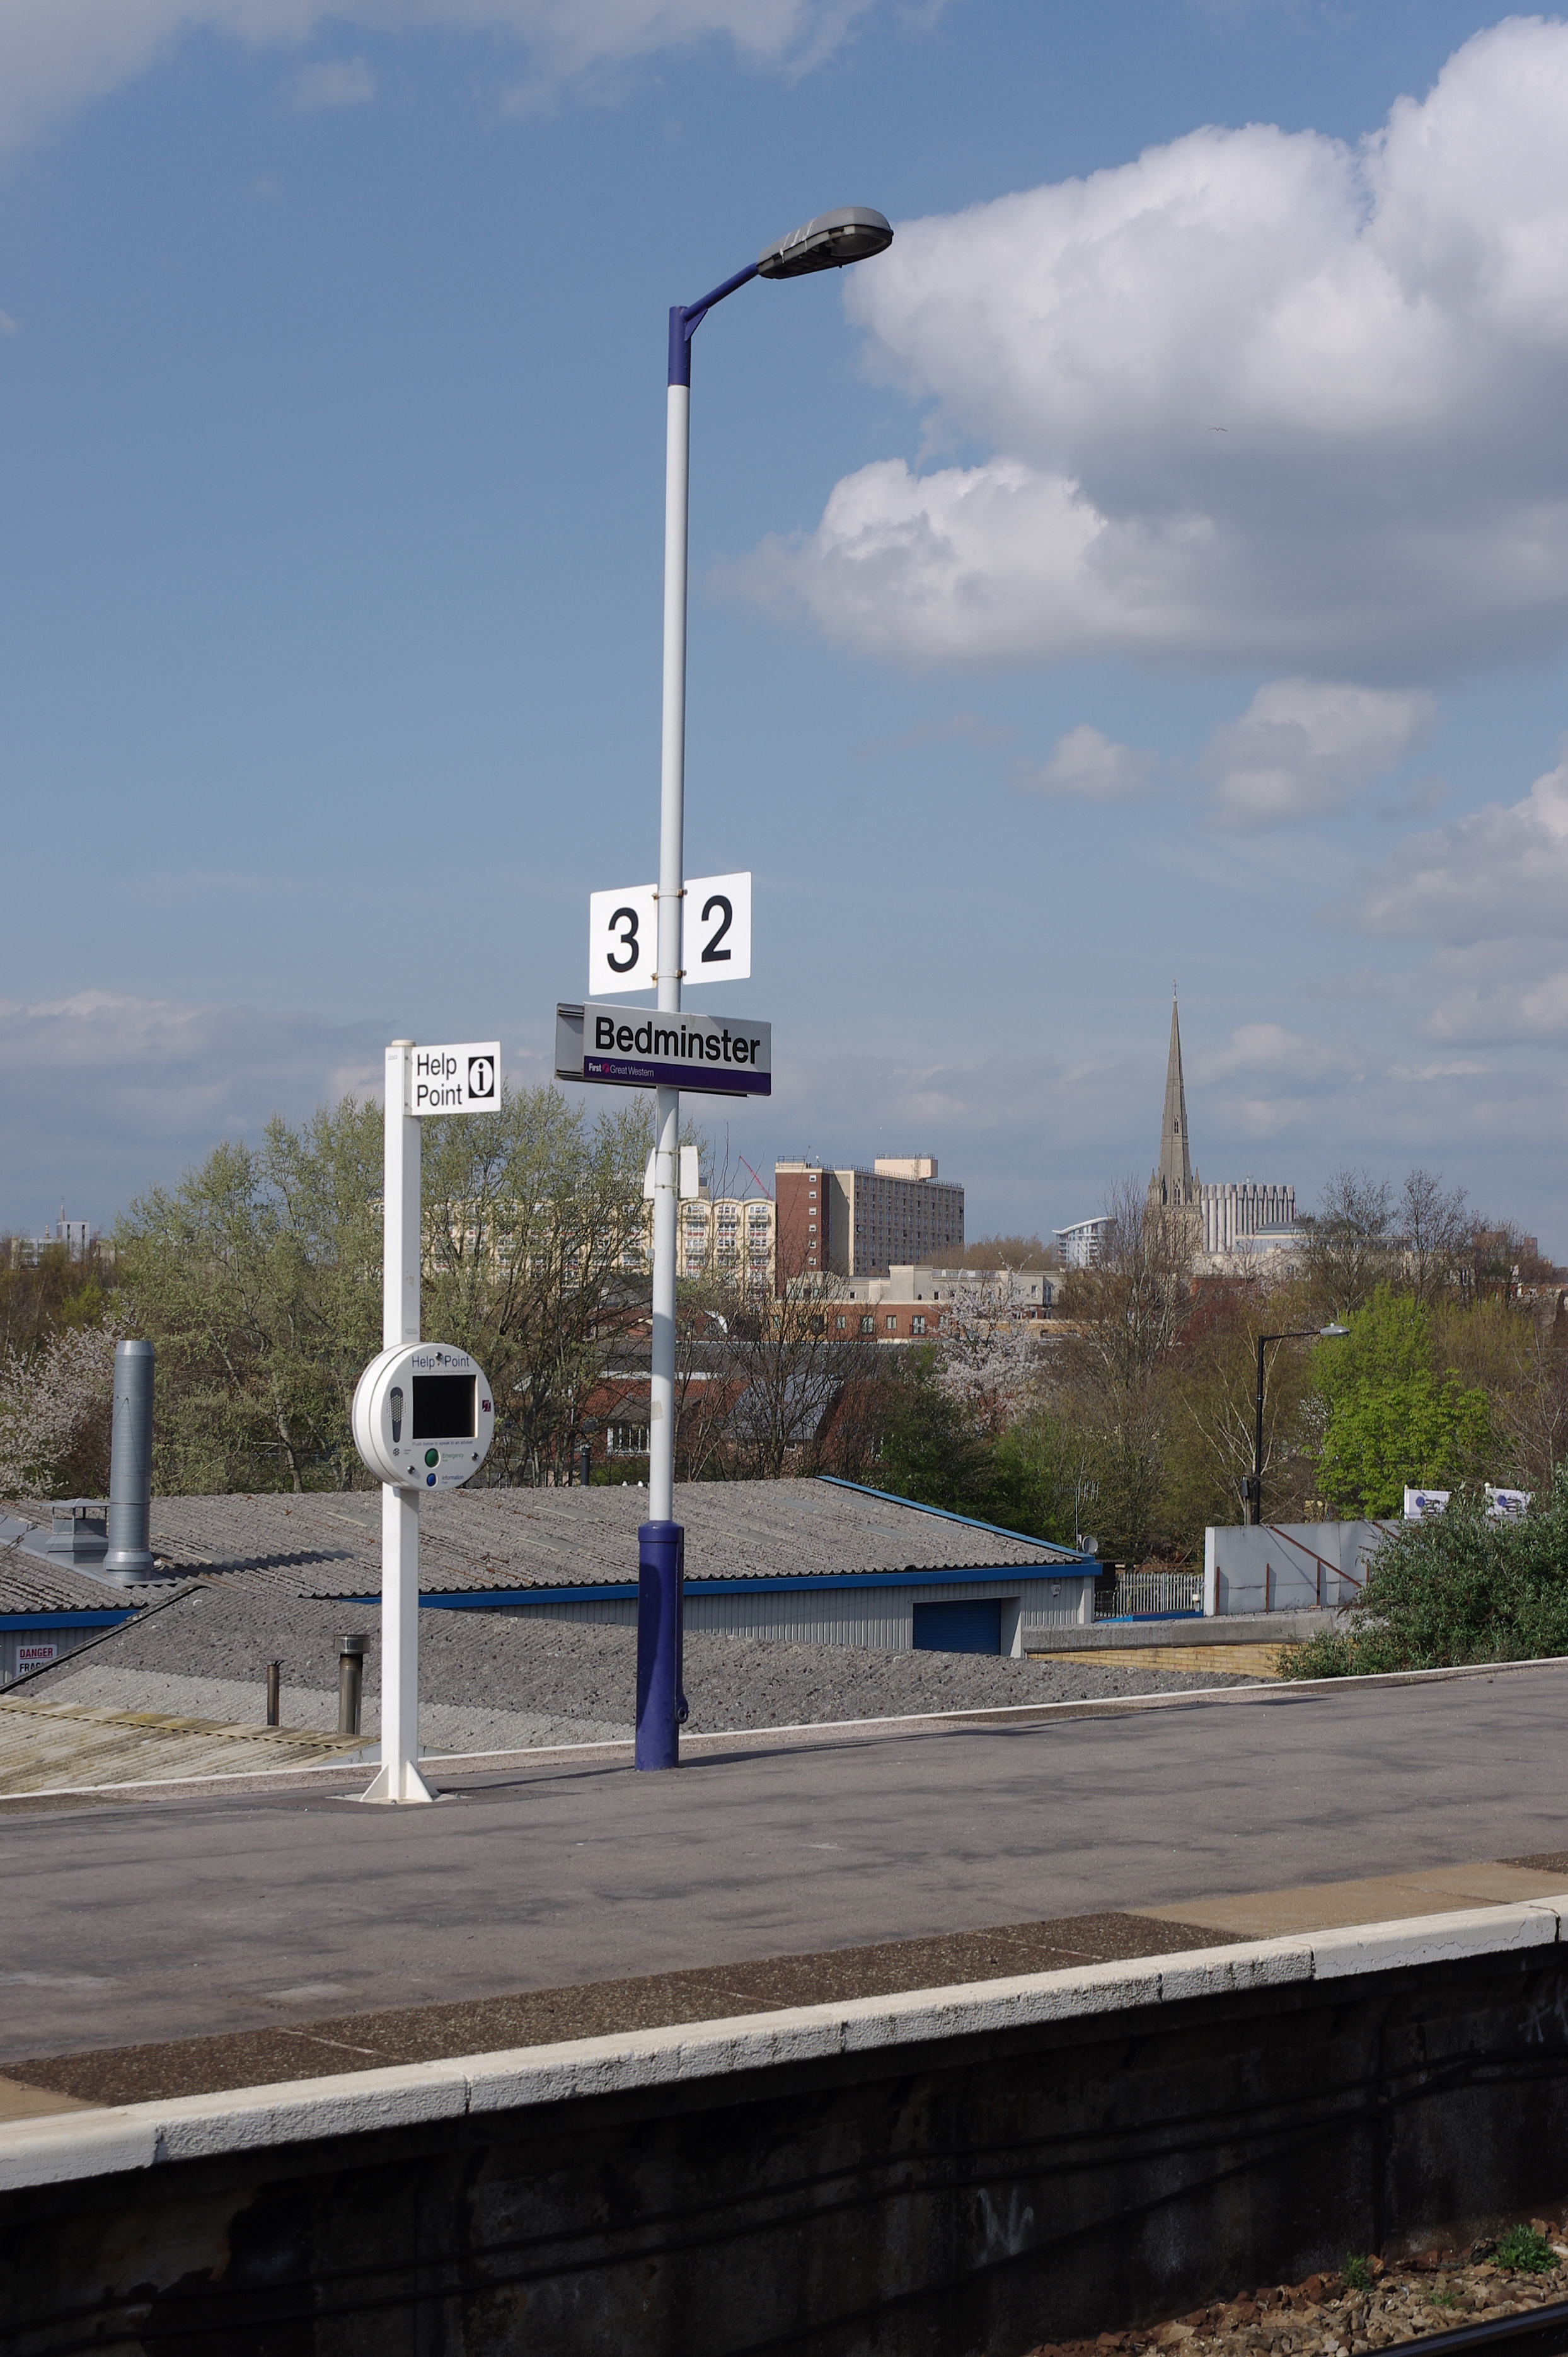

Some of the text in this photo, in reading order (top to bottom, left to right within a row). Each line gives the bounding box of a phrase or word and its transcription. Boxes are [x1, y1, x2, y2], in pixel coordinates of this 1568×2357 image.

[607, 908, 640, 973] 3
[700, 895, 733, 963] 2
[596, 1017, 761, 1064] Bedminster
[417, 1052, 457, 1080] Help
[588, 1063, 655, 1077] First Great Western
[417, 1083, 463, 1107] Point
[412, 1355, 470, 1370] Help Point
[20, 1648, 53, 1657] DANGER
